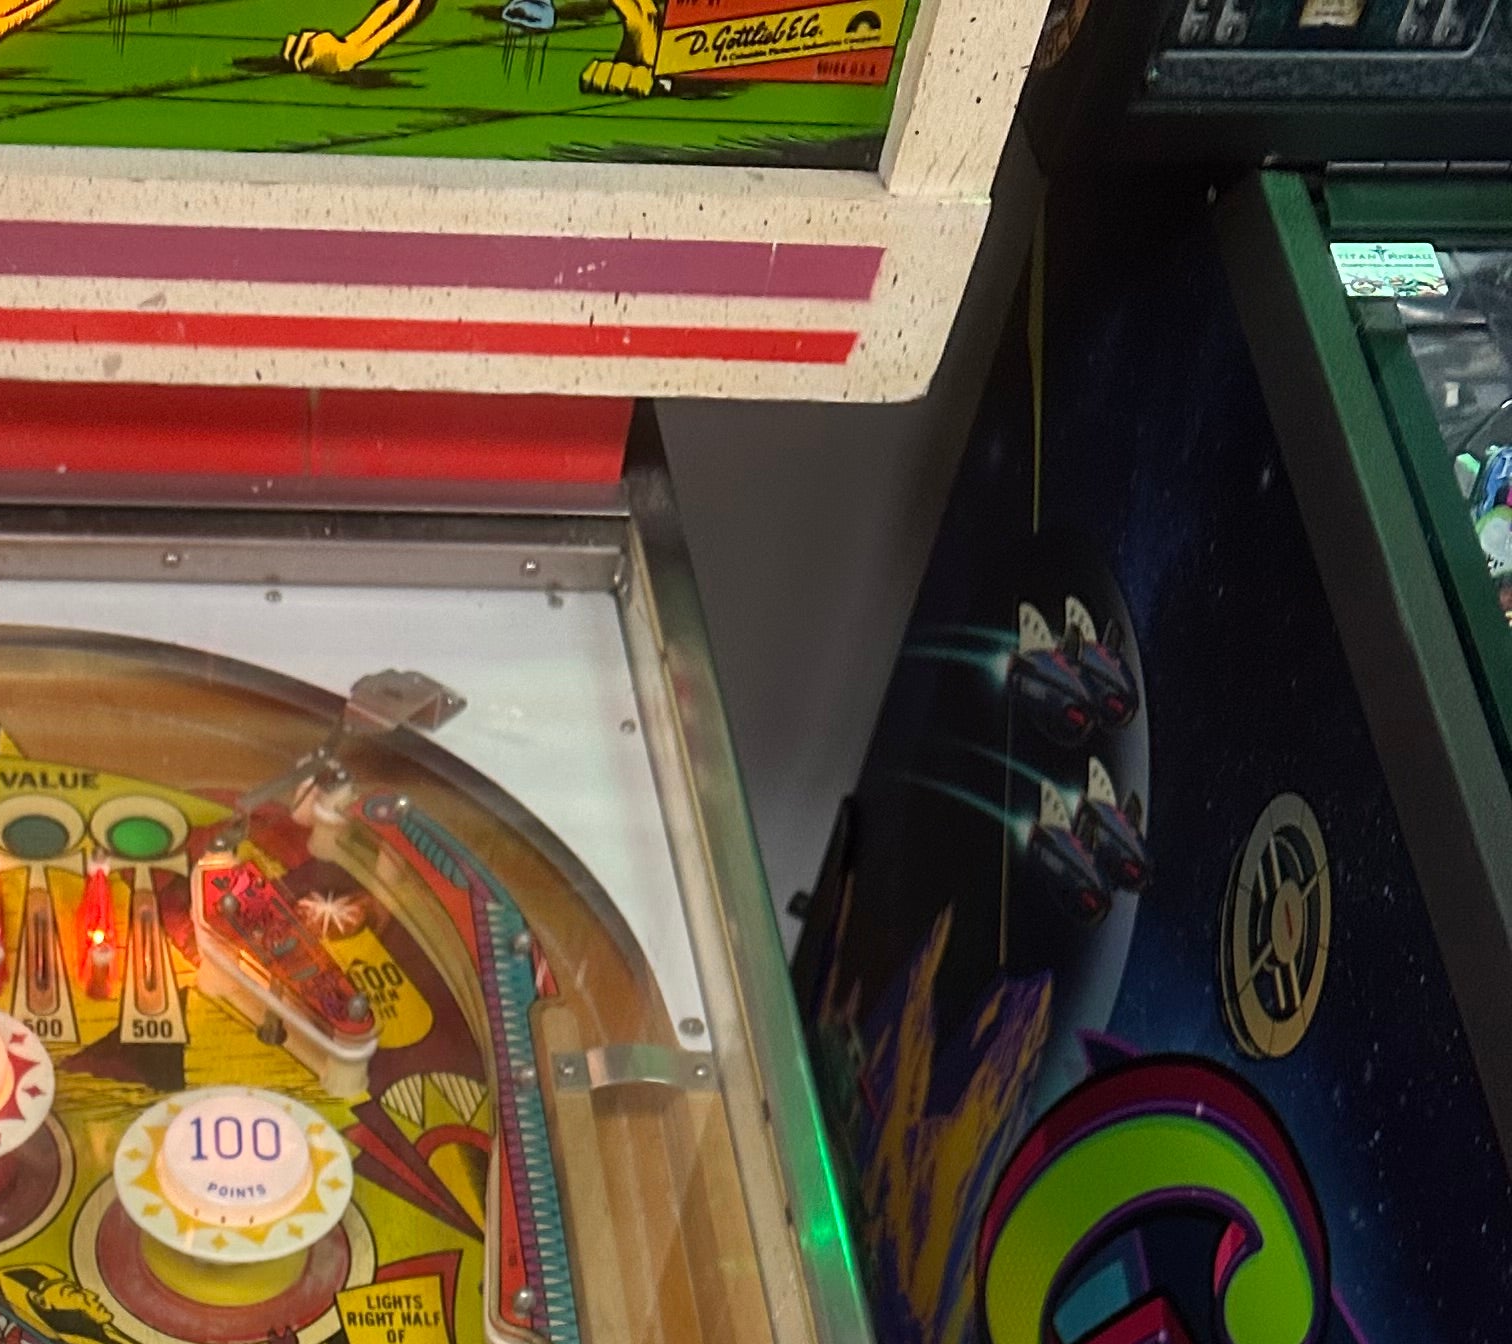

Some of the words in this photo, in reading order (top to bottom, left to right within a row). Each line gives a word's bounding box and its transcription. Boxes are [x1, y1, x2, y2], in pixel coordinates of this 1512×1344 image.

[132, 1019, 173, 1039] 500
[190, 1116, 281, 1162] 100
[207, 1182, 266, 1199] POINTS
[366, 1295, 423, 1311] LIGHTS
[347, 1311, 395, 1327] RIGHT
[401, 1311, 441, 1327] HALF
[386, 1329, 405, 1344] OF
